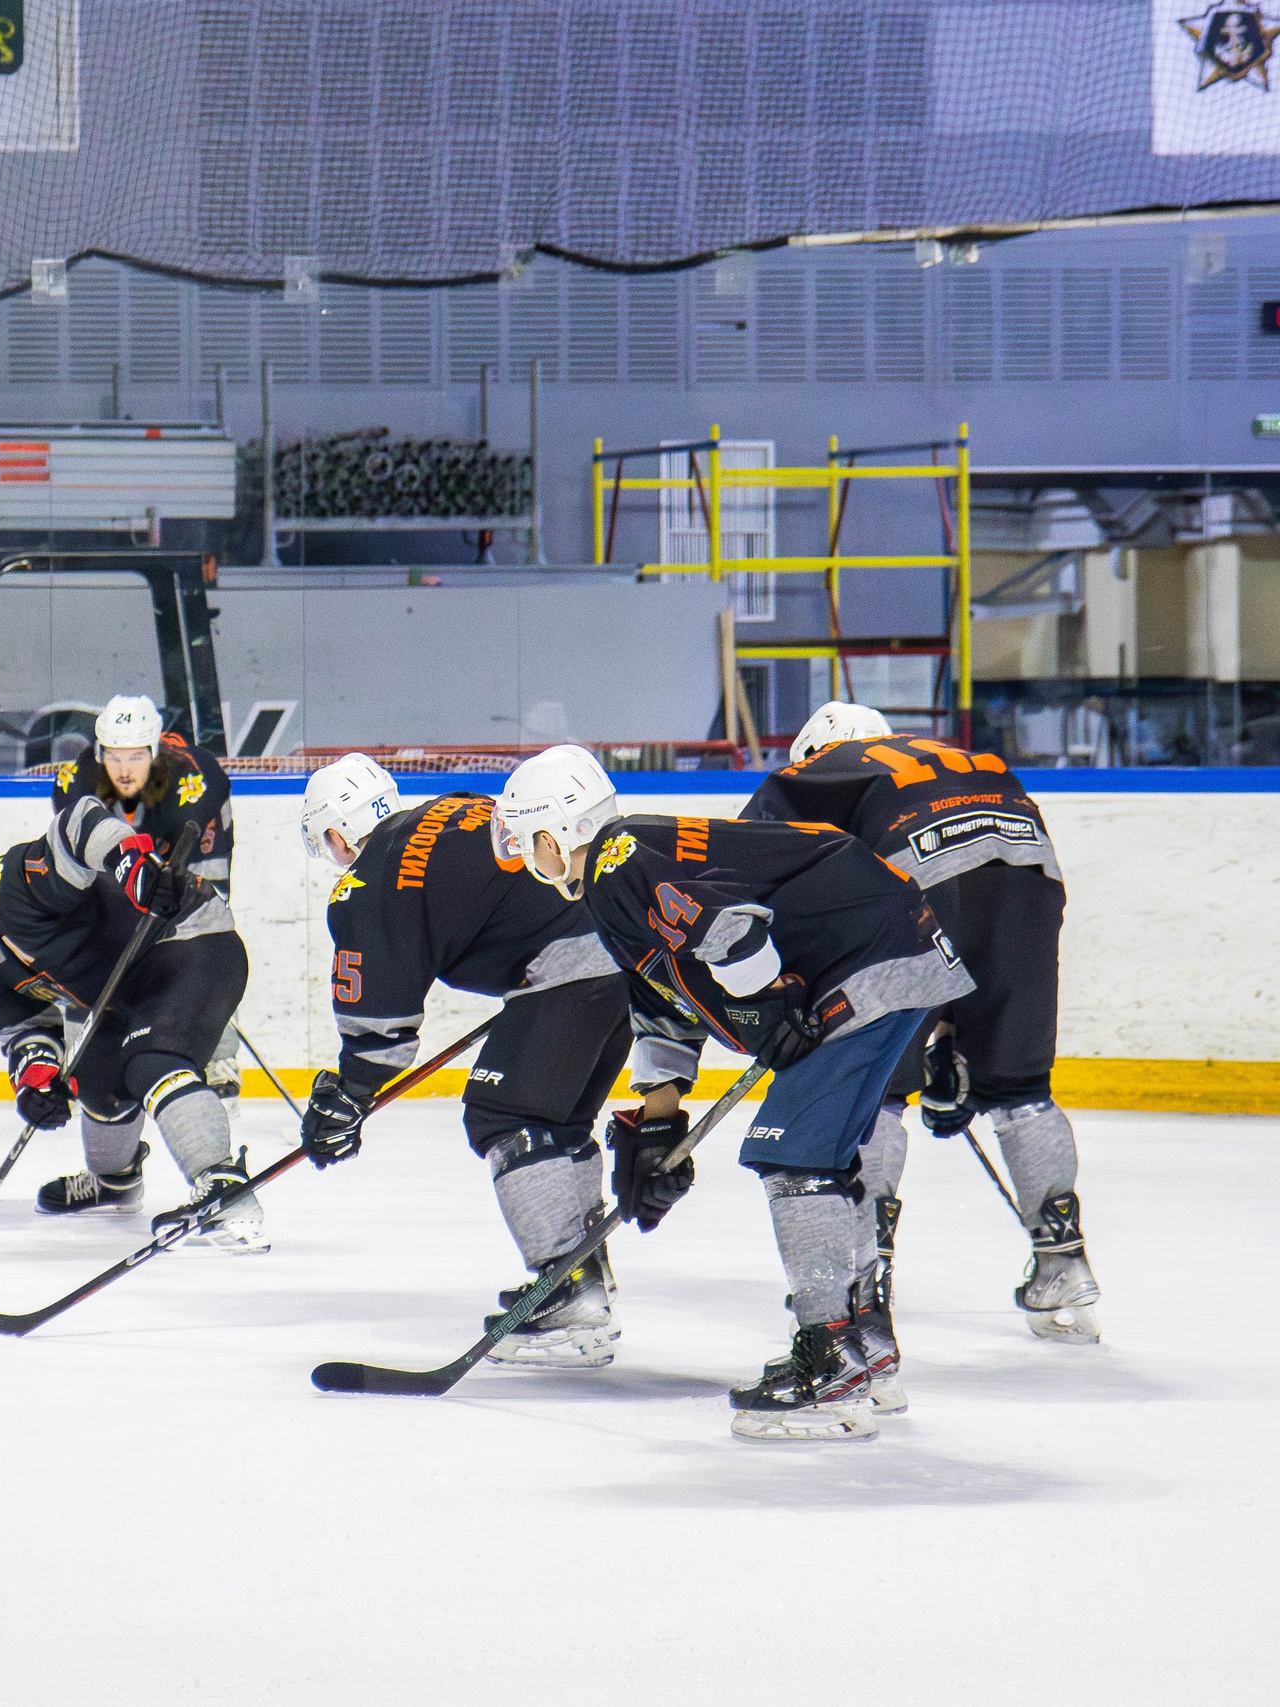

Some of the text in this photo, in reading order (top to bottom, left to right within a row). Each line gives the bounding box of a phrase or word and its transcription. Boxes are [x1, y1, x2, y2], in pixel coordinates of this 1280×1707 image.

[115, 712, 132, 725] 24
[371, 796, 391, 820] 25
[519, 804, 550, 816] BAUER
[928, 793, 1004, 813] ДОБРОФЛОТ
[941, 817, 994, 838] ГЕОМЕТРИЯ
[648, 882, 704, 953] 14
[332, 949, 363, 1004] 5
